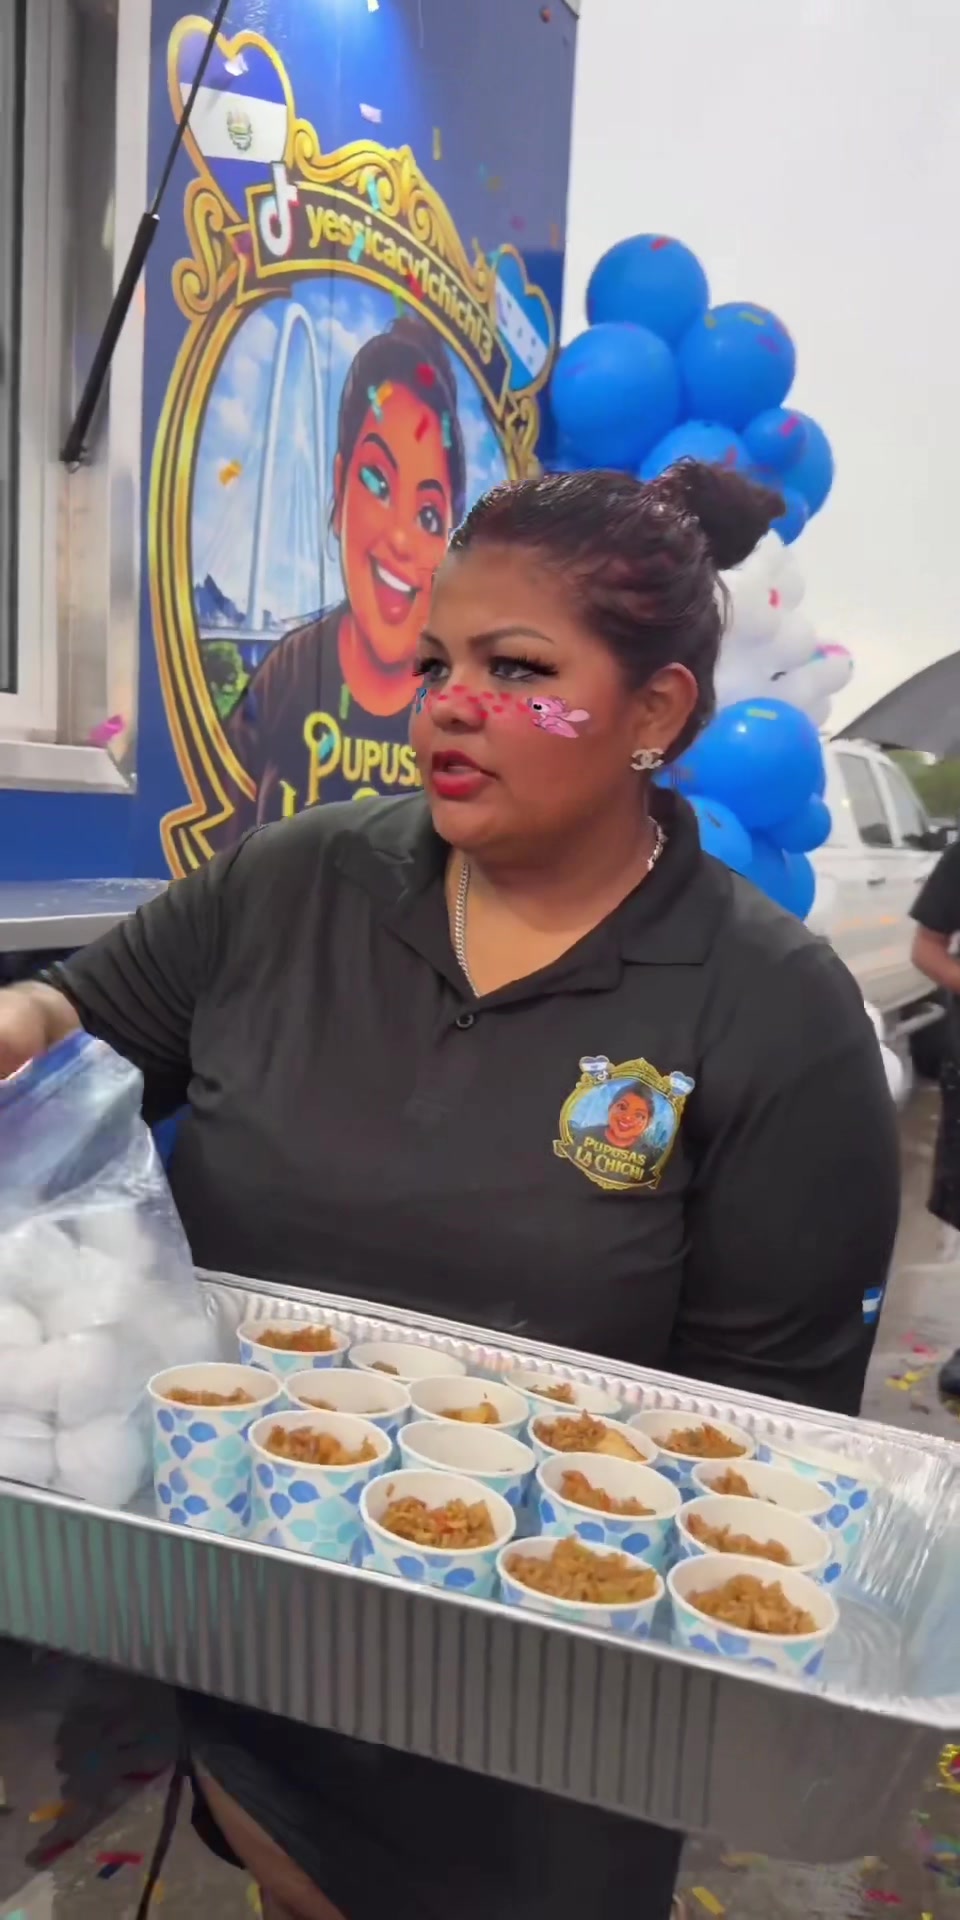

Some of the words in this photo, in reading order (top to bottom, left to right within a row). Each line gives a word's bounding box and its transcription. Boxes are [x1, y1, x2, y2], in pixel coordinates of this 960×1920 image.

[303, 711, 422, 806] PUPUS
[575, 1146, 593, 1168] LA
[594, 1154, 645, 1180] CHICHI
[583, 1136, 647, 1166] PUPUSAS
